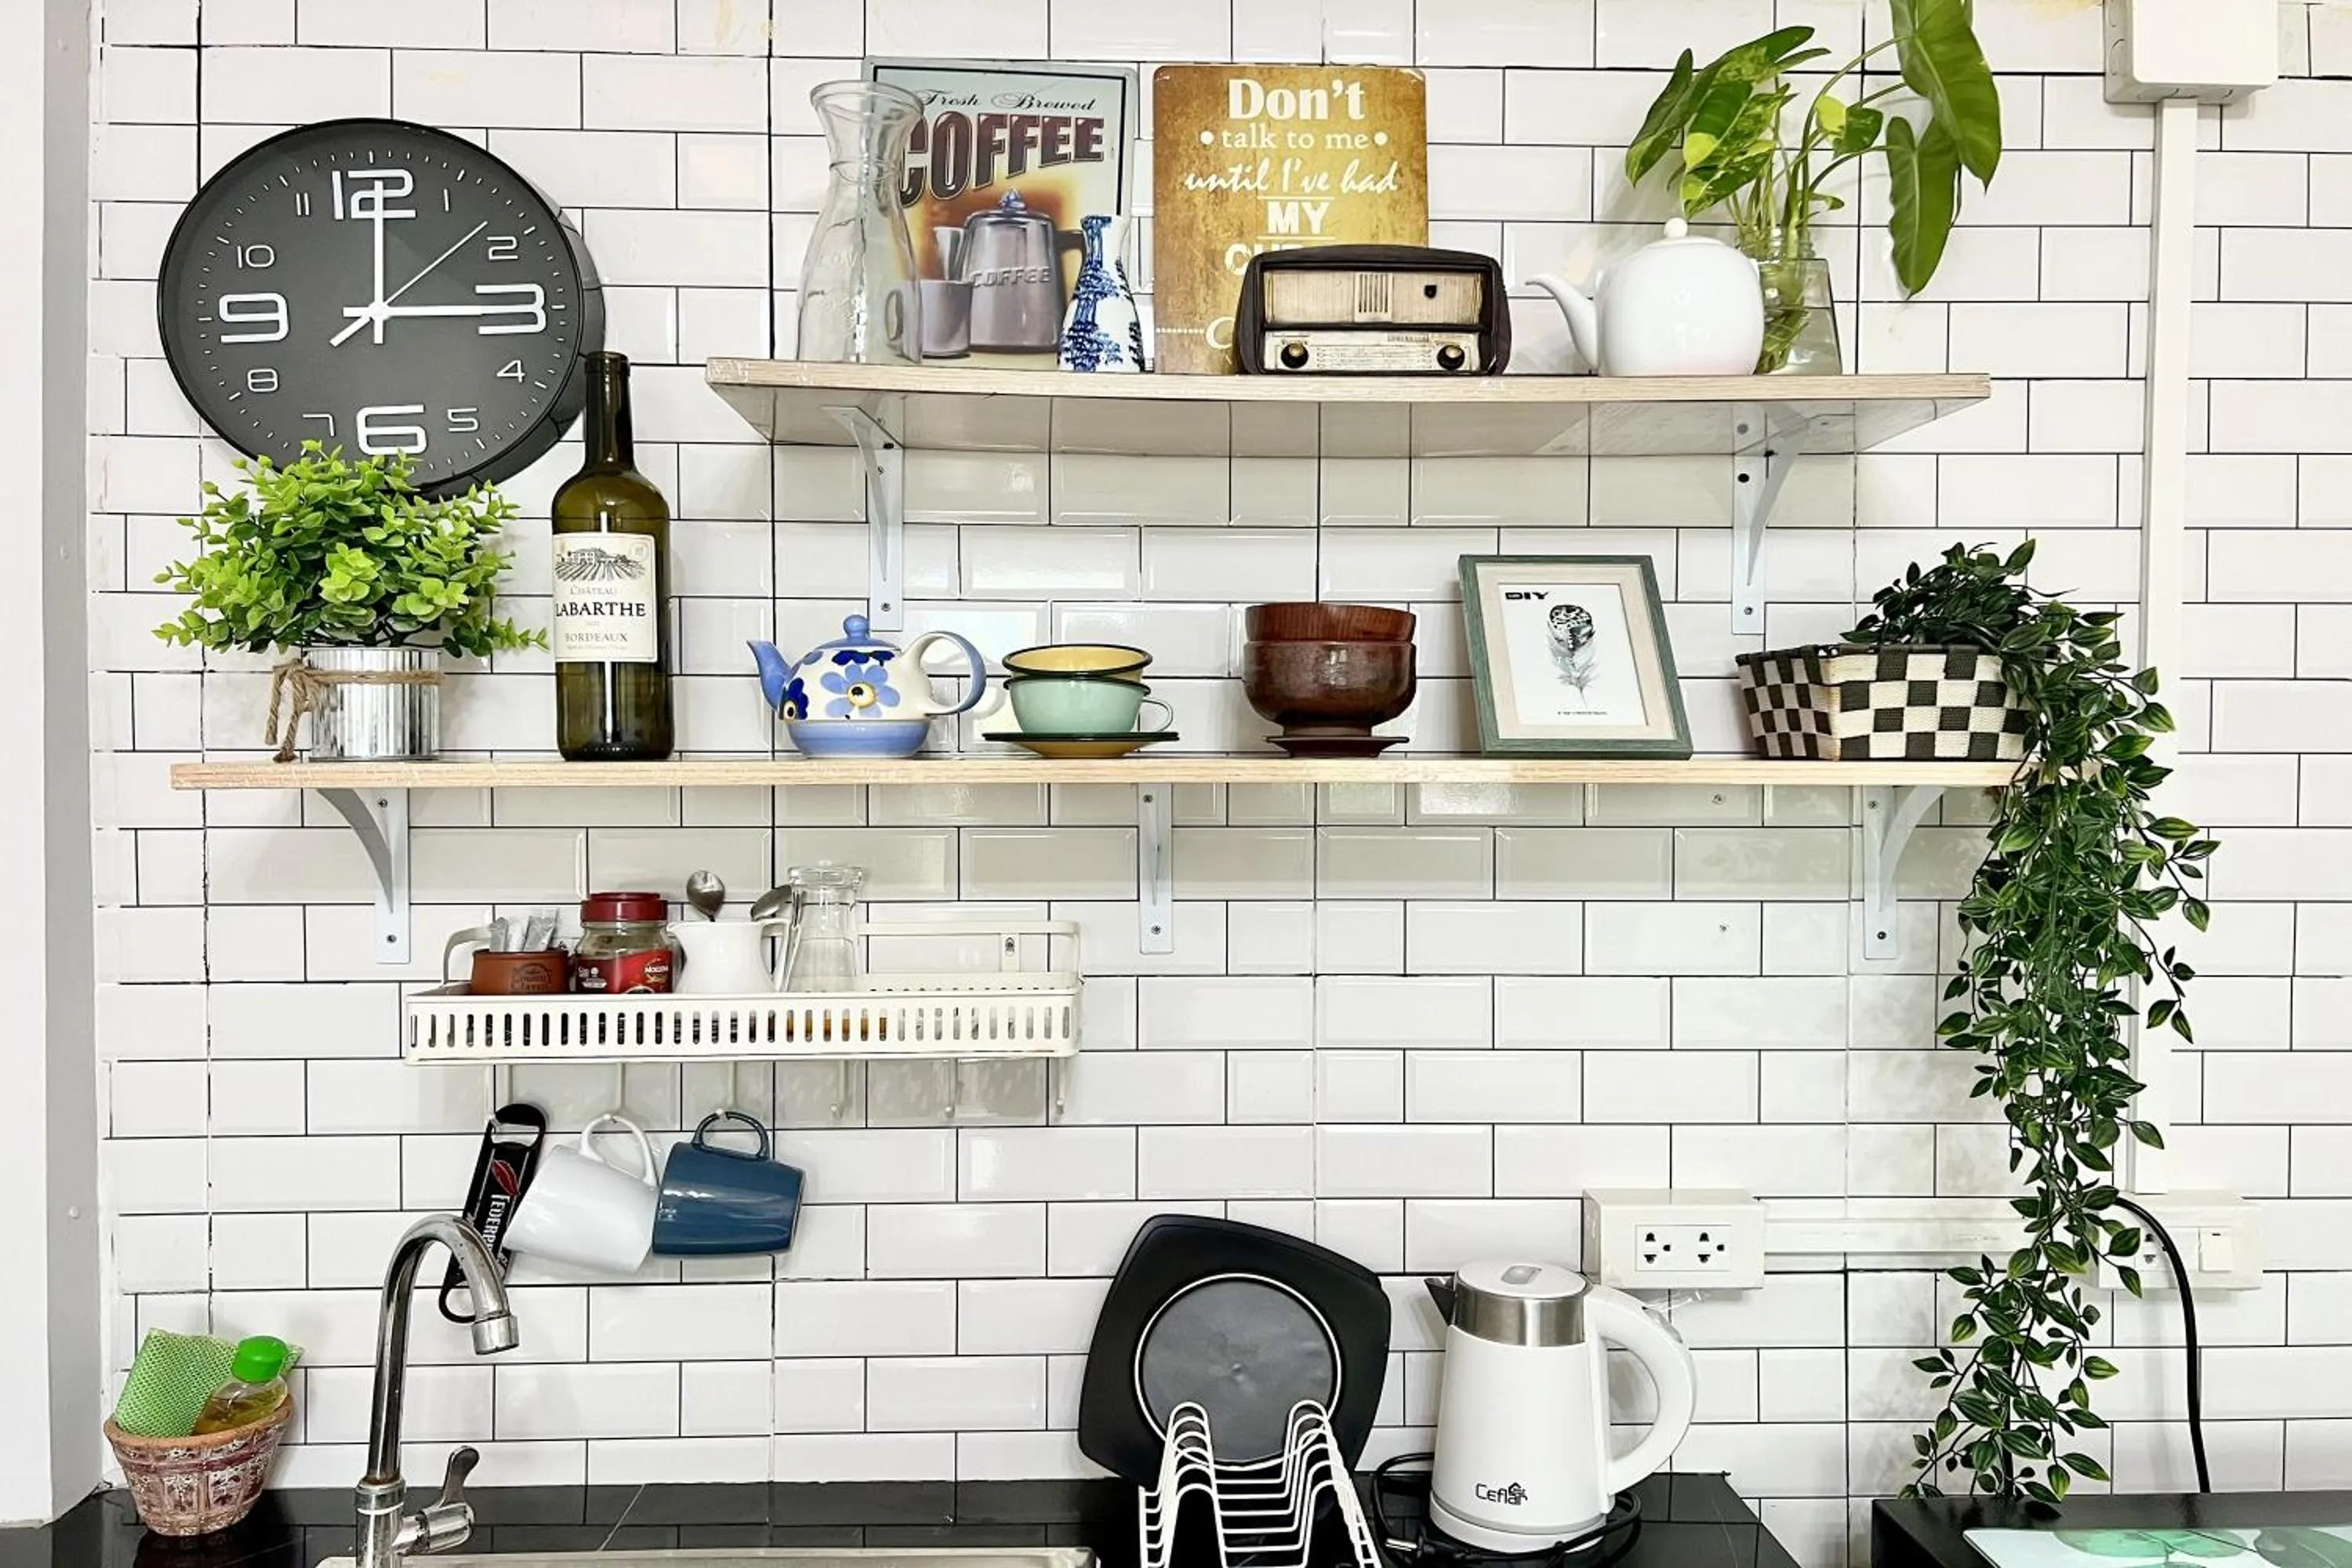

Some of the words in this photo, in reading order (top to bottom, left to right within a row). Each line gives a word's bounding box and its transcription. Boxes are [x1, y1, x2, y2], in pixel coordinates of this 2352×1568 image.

[991, 92, 1096, 111] Brewed
[1229, 79, 1364, 120] Don't
[1222, 124, 1277, 148] talk
[1288, 131, 1315, 148] to
[1326, 132, 1368, 148] me
[898, 111, 1104, 209] COFFEE
[1185, 158, 1269, 191] until
[1282, 158, 1330, 193] I've
[1341, 158, 1398, 194] had
[295, 192, 310, 216] 11
[332, 169, 416, 220] 12
[1269, 201, 1330, 234] MY
[237, 245, 274, 268] 10
[487, 236, 518, 260] 2
[219, 292, 288, 343] 9
[475, 283, 546, 335] 3
[247, 368, 278, 392] 8
[496, 359, 524, 383] 4
[303, 413, 335, 436] 7
[356, 405, 426, 455] 6
[446, 407, 478, 431] 5
[556, 601, 647, 617] LABARTHE
[566, 633, 627, 642] BORDEAUX
